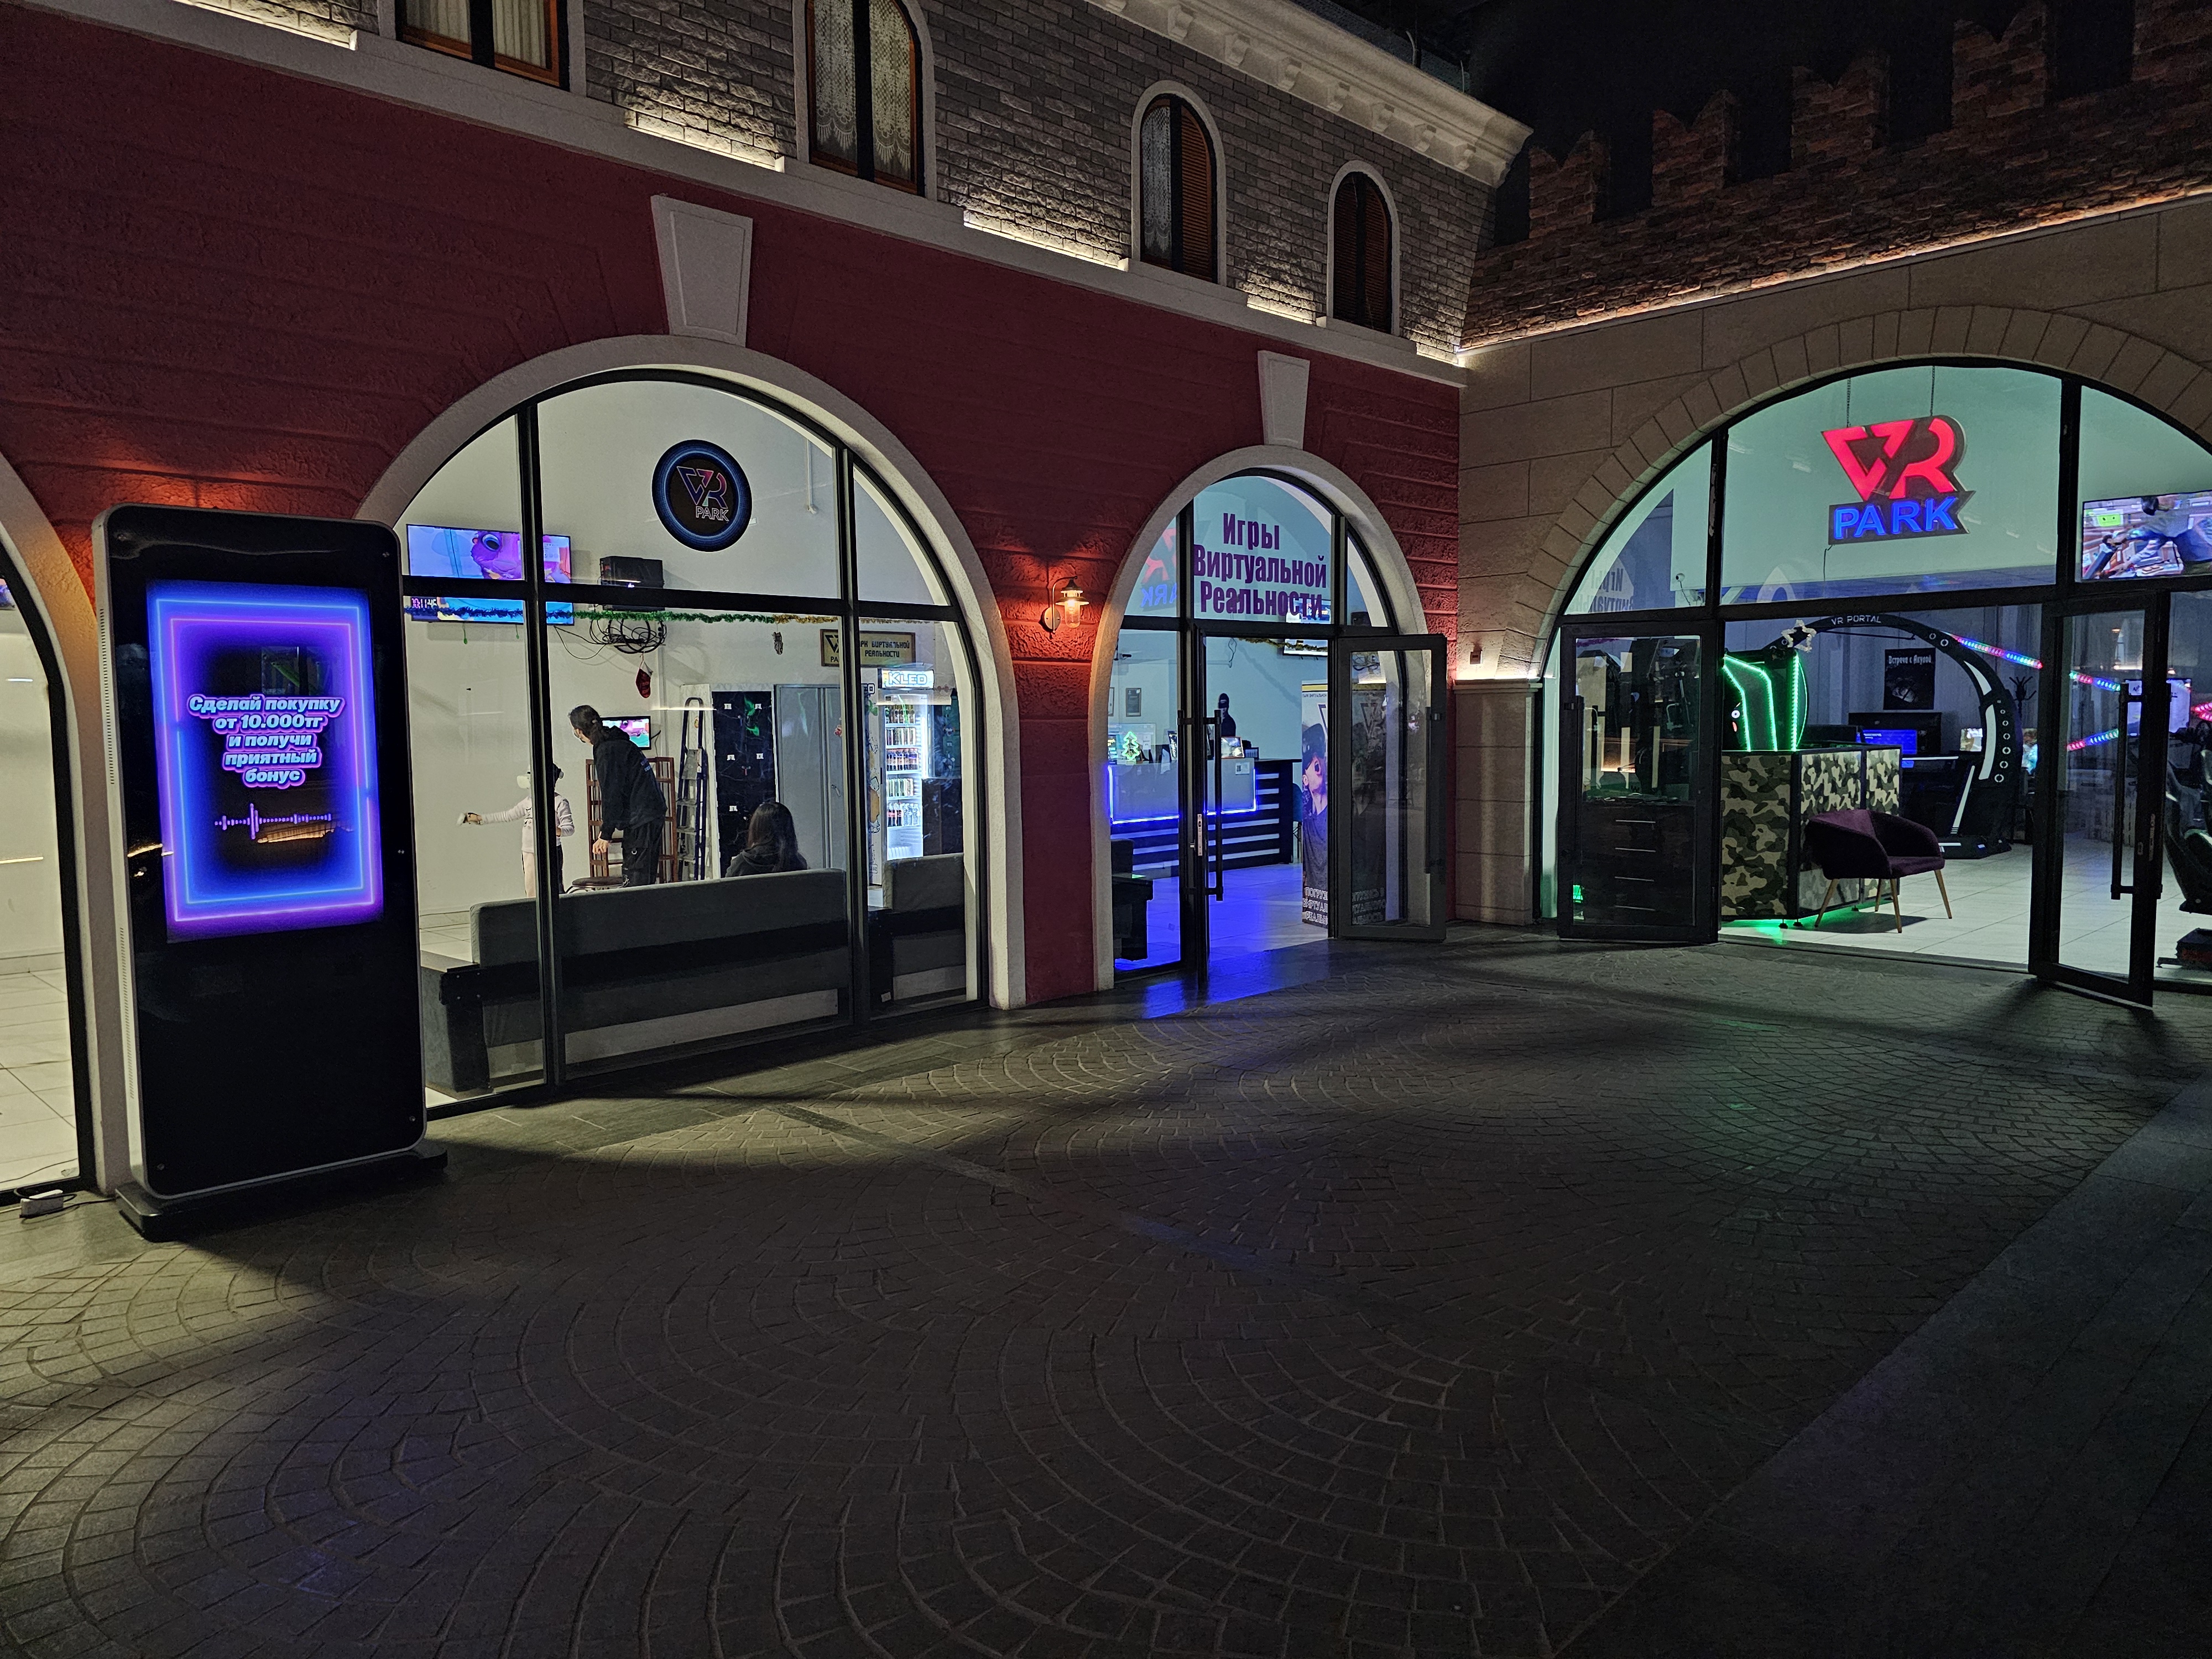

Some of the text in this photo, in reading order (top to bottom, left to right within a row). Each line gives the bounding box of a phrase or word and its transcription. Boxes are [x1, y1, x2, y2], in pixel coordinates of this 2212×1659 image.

[1823, 418, 1958, 502] VR
[676, 466, 728, 509] VR
[696, 506, 729, 521] PARK
[1834, 496, 1958, 539] PARK
[1223, 513, 1279, 550] Игры
[1194, 544, 1326, 588] Виртуальной
[1200, 581, 1322, 618] Реальности
[1831, 615, 1881, 625] VR PORTAL
[888, 671, 927, 685] KLEO
[189, 696, 341, 713] Сделай покупку
[215, 714, 323, 729] от 10.000тг
[228, 735, 312, 748] и получи
[225, 749, 317, 767] приятный
[245, 768, 300, 784] бонус
[1305, 886, 1328, 901] ПОГРУЗ
[1302, 898, 1328, 913] ВИРТУАЛ
[1306, 911, 1328, 926] РЕАЛЬН
